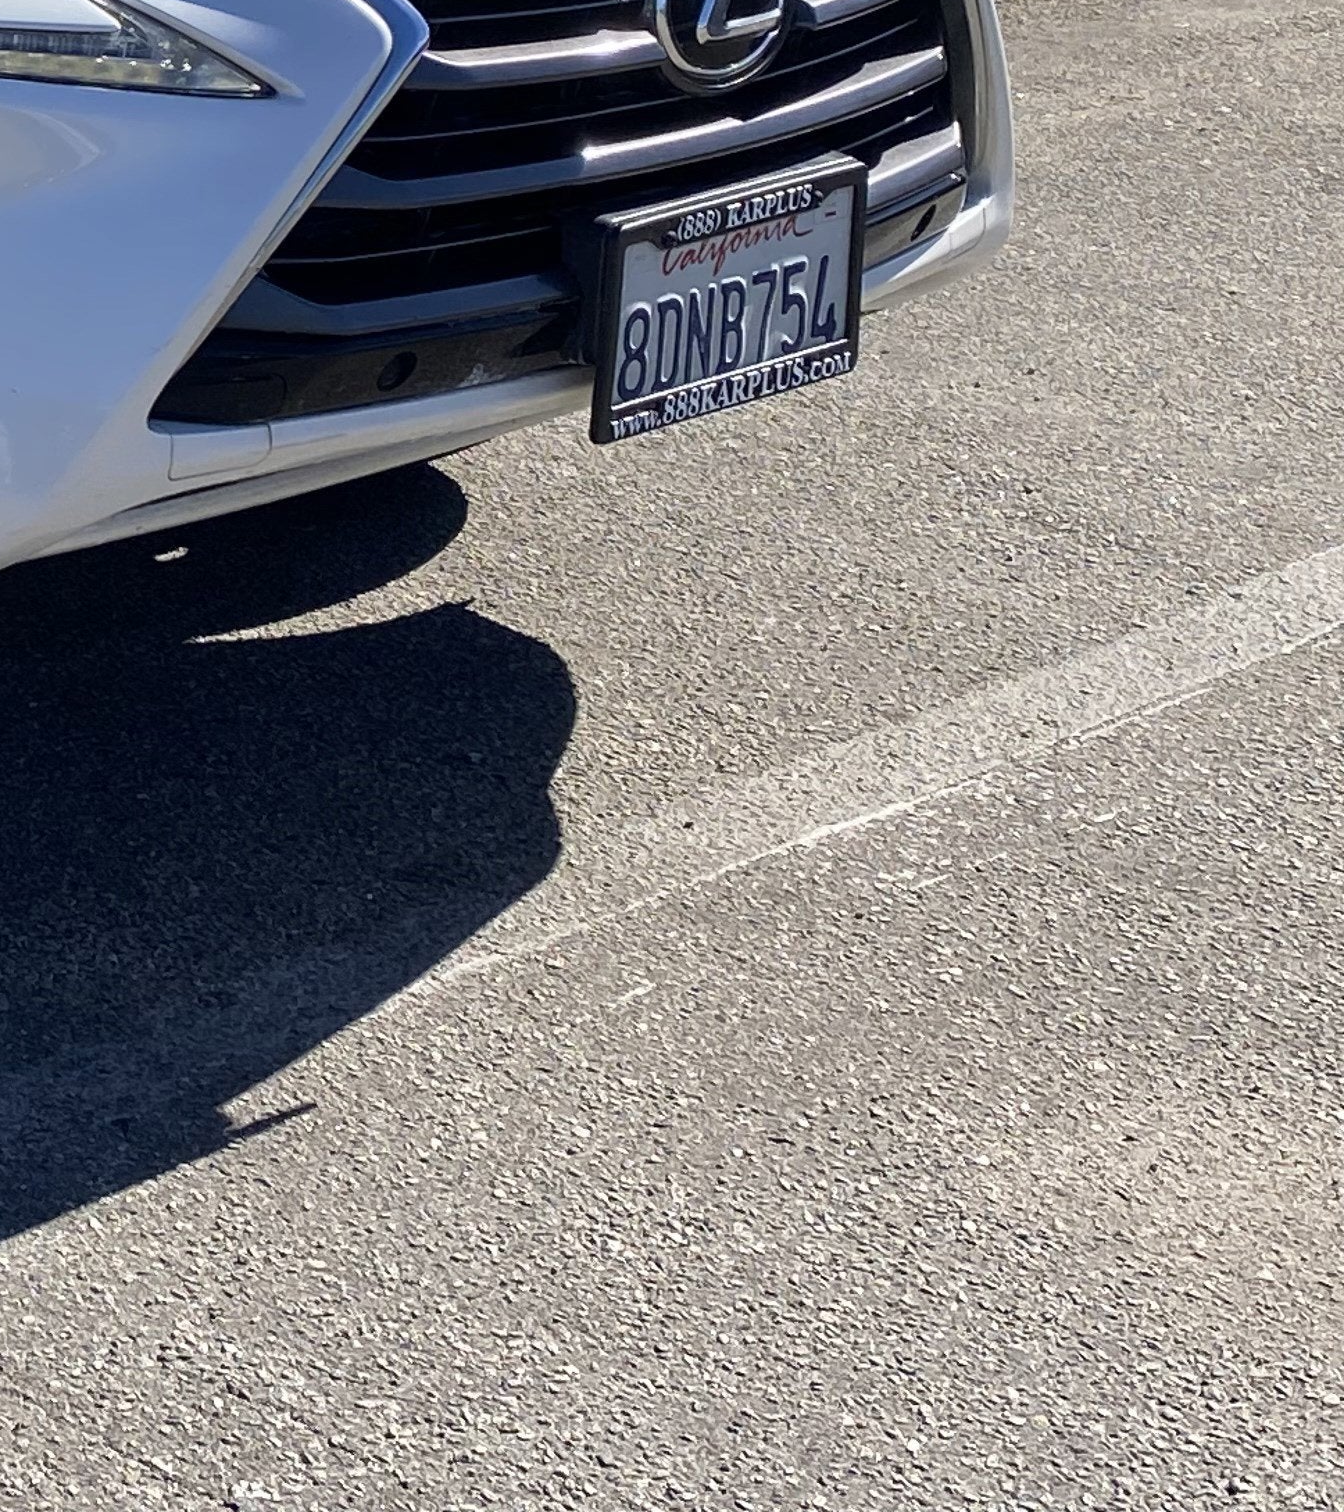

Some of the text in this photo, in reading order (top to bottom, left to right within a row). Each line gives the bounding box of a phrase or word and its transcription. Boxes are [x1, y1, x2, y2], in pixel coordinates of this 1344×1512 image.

[677, 184, 813, 241] (888) KARPLUS
[662, 215, 814, 277] California
[616, 254, 838, 402] 8DNB754
